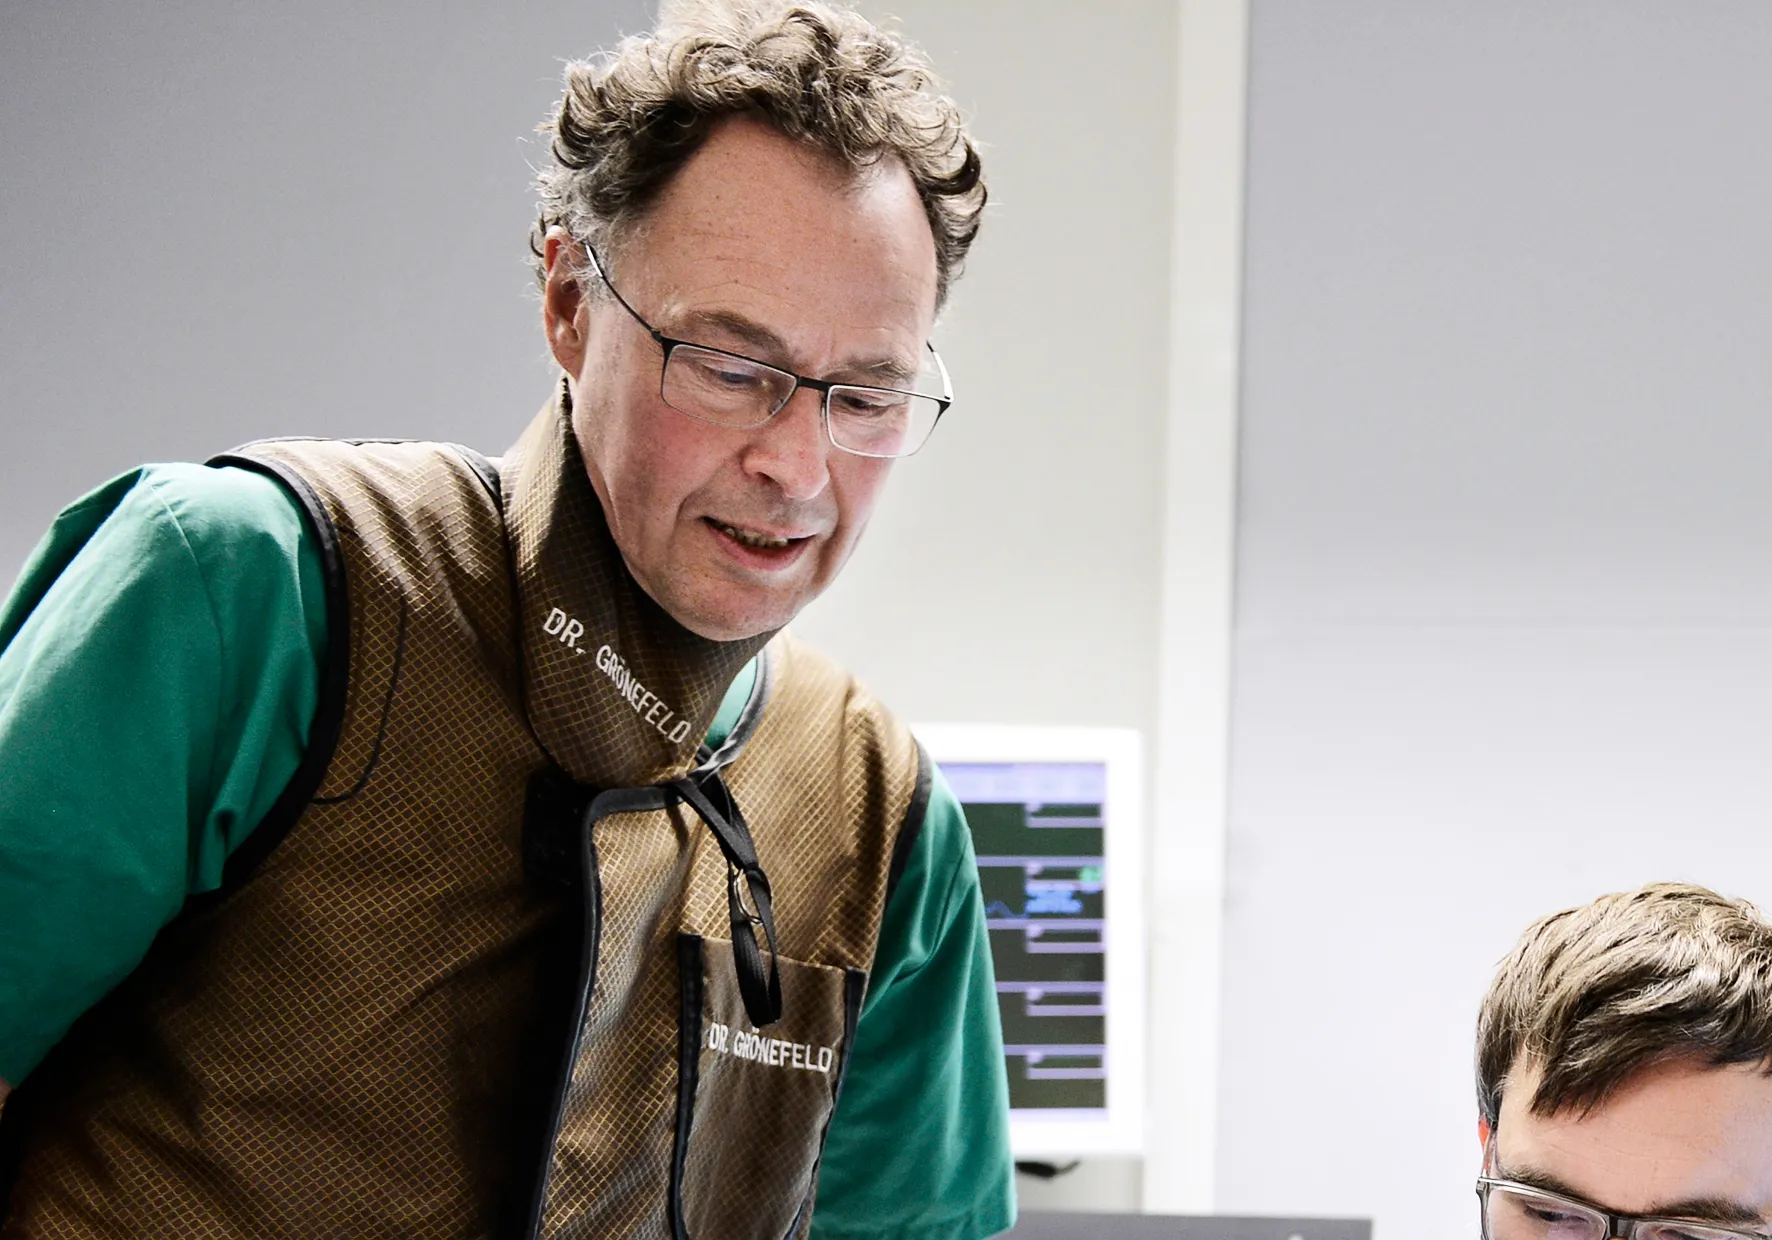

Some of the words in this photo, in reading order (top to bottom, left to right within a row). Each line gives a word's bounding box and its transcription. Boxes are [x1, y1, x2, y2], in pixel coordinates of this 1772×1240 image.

[543, 607, 586, 655] DR.
[596, 645, 691, 743] GRÖNEFELD
[708, 1022, 729, 1054] DR.
[733, 1025, 833, 1074] GRÖNEFELD
